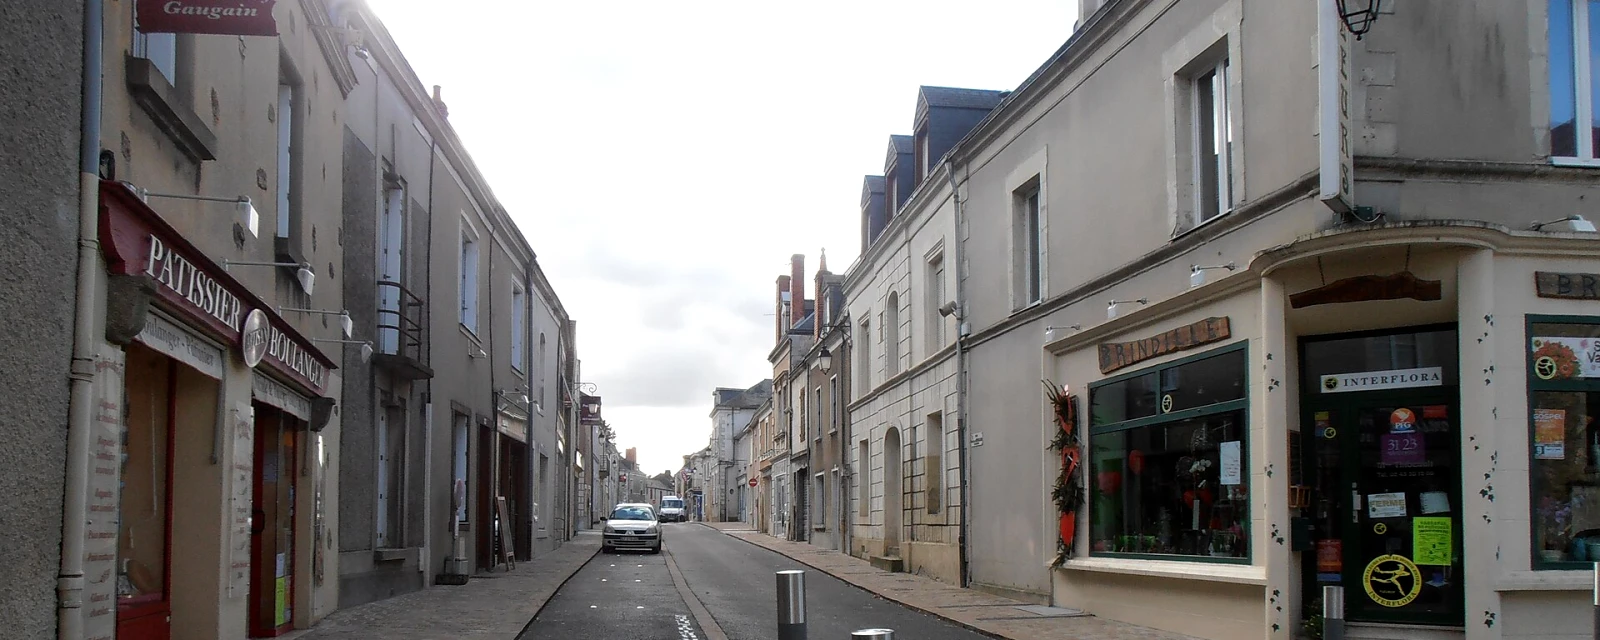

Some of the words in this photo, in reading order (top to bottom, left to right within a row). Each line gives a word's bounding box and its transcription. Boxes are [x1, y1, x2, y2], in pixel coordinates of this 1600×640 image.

[163, 1, 257, 19] Gaugain
[145, 233, 240, 332] PATISSIER
[1101, 319, 1218, 369] BRINDILLE
[269, 326, 325, 390] BOULANGER
[1343, 372, 1439, 387] INTERFLORA
[1387, 439, 1399, 451] 31
[1369, 590, 1416, 606] INTERFLORA
